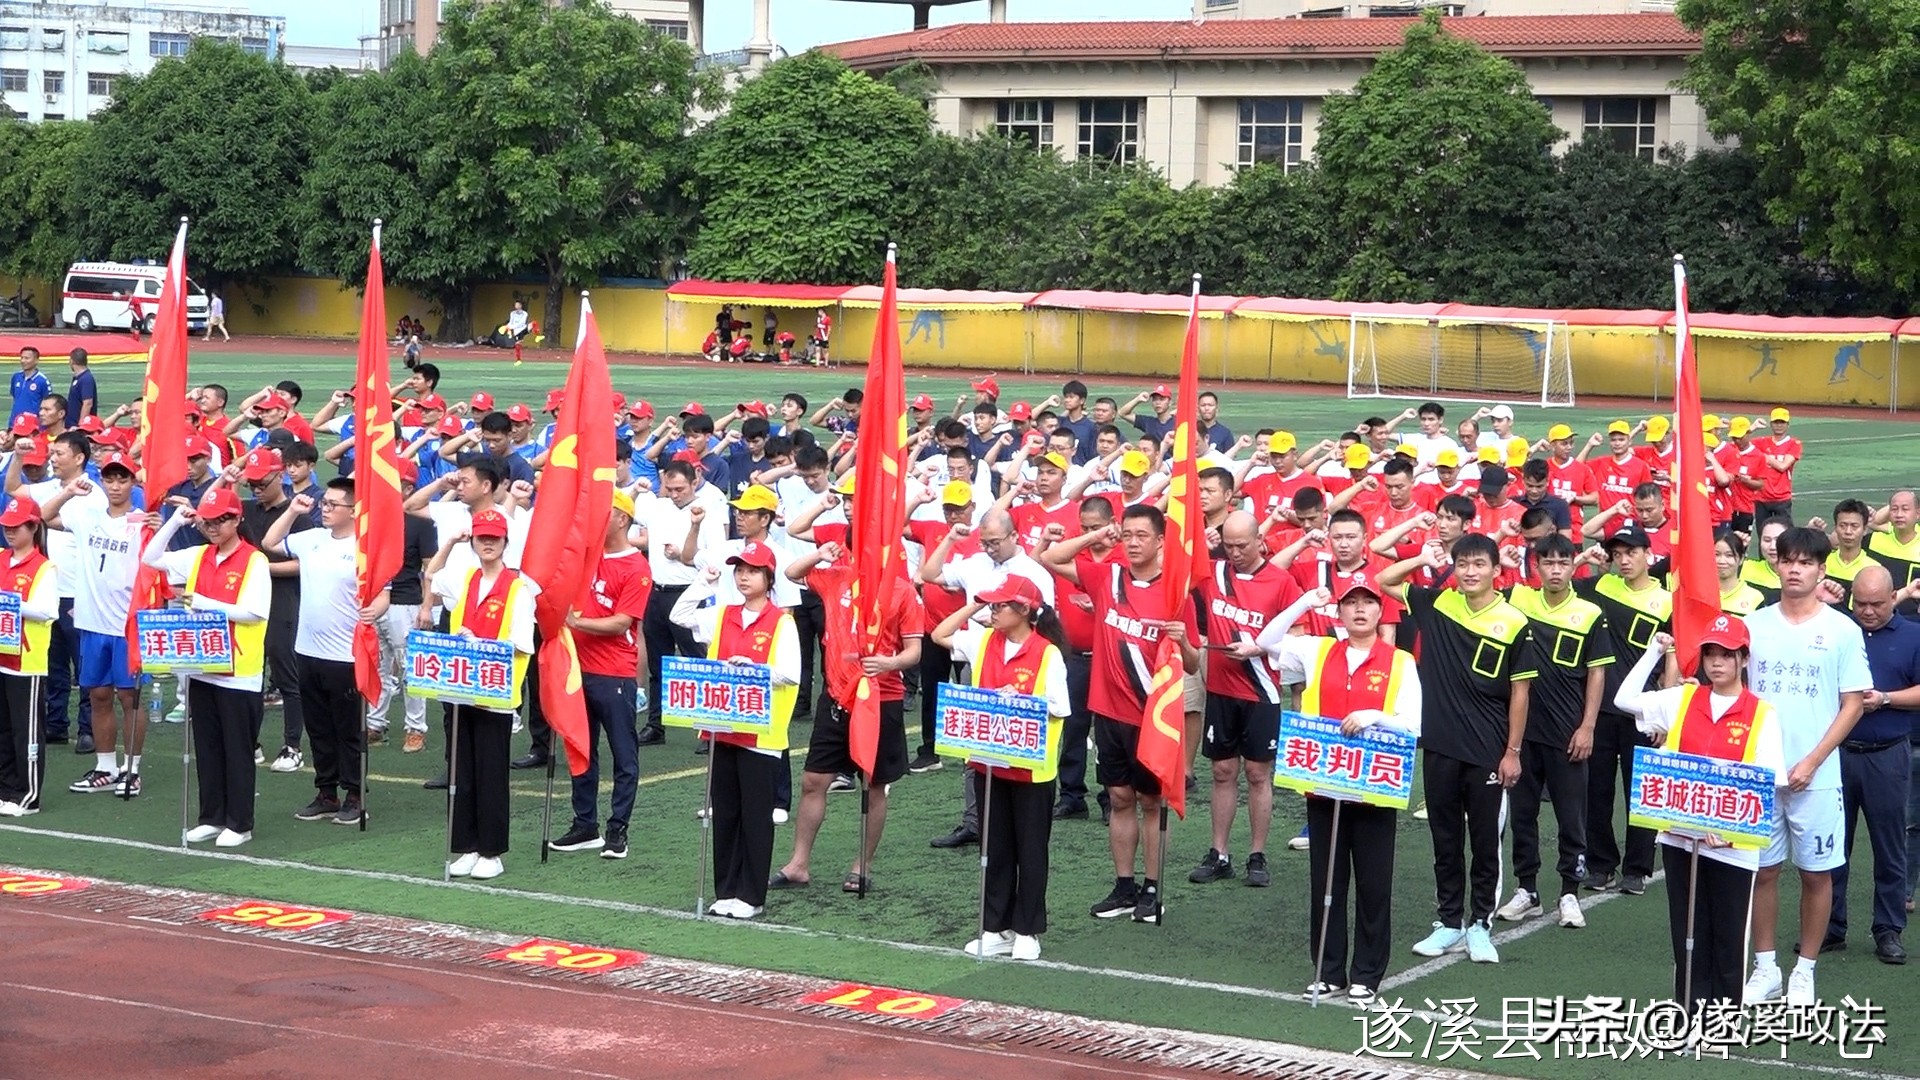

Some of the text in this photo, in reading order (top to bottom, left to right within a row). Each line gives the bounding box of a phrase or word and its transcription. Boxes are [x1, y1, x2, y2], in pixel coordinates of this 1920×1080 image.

[99, 553, 106, 572] 1
[146, 629, 225, 656] 洋青镇
[415, 653, 506, 690] 岭北镇
[669, 681, 764, 715] 附城镇
[944, 708, 1040, 749] 遂溪县公安局
[1286, 738, 1403, 787] 裁判员
[1641, 775, 1763, 824] 遂城街道办
[1814, 833, 1834, 855] 14
